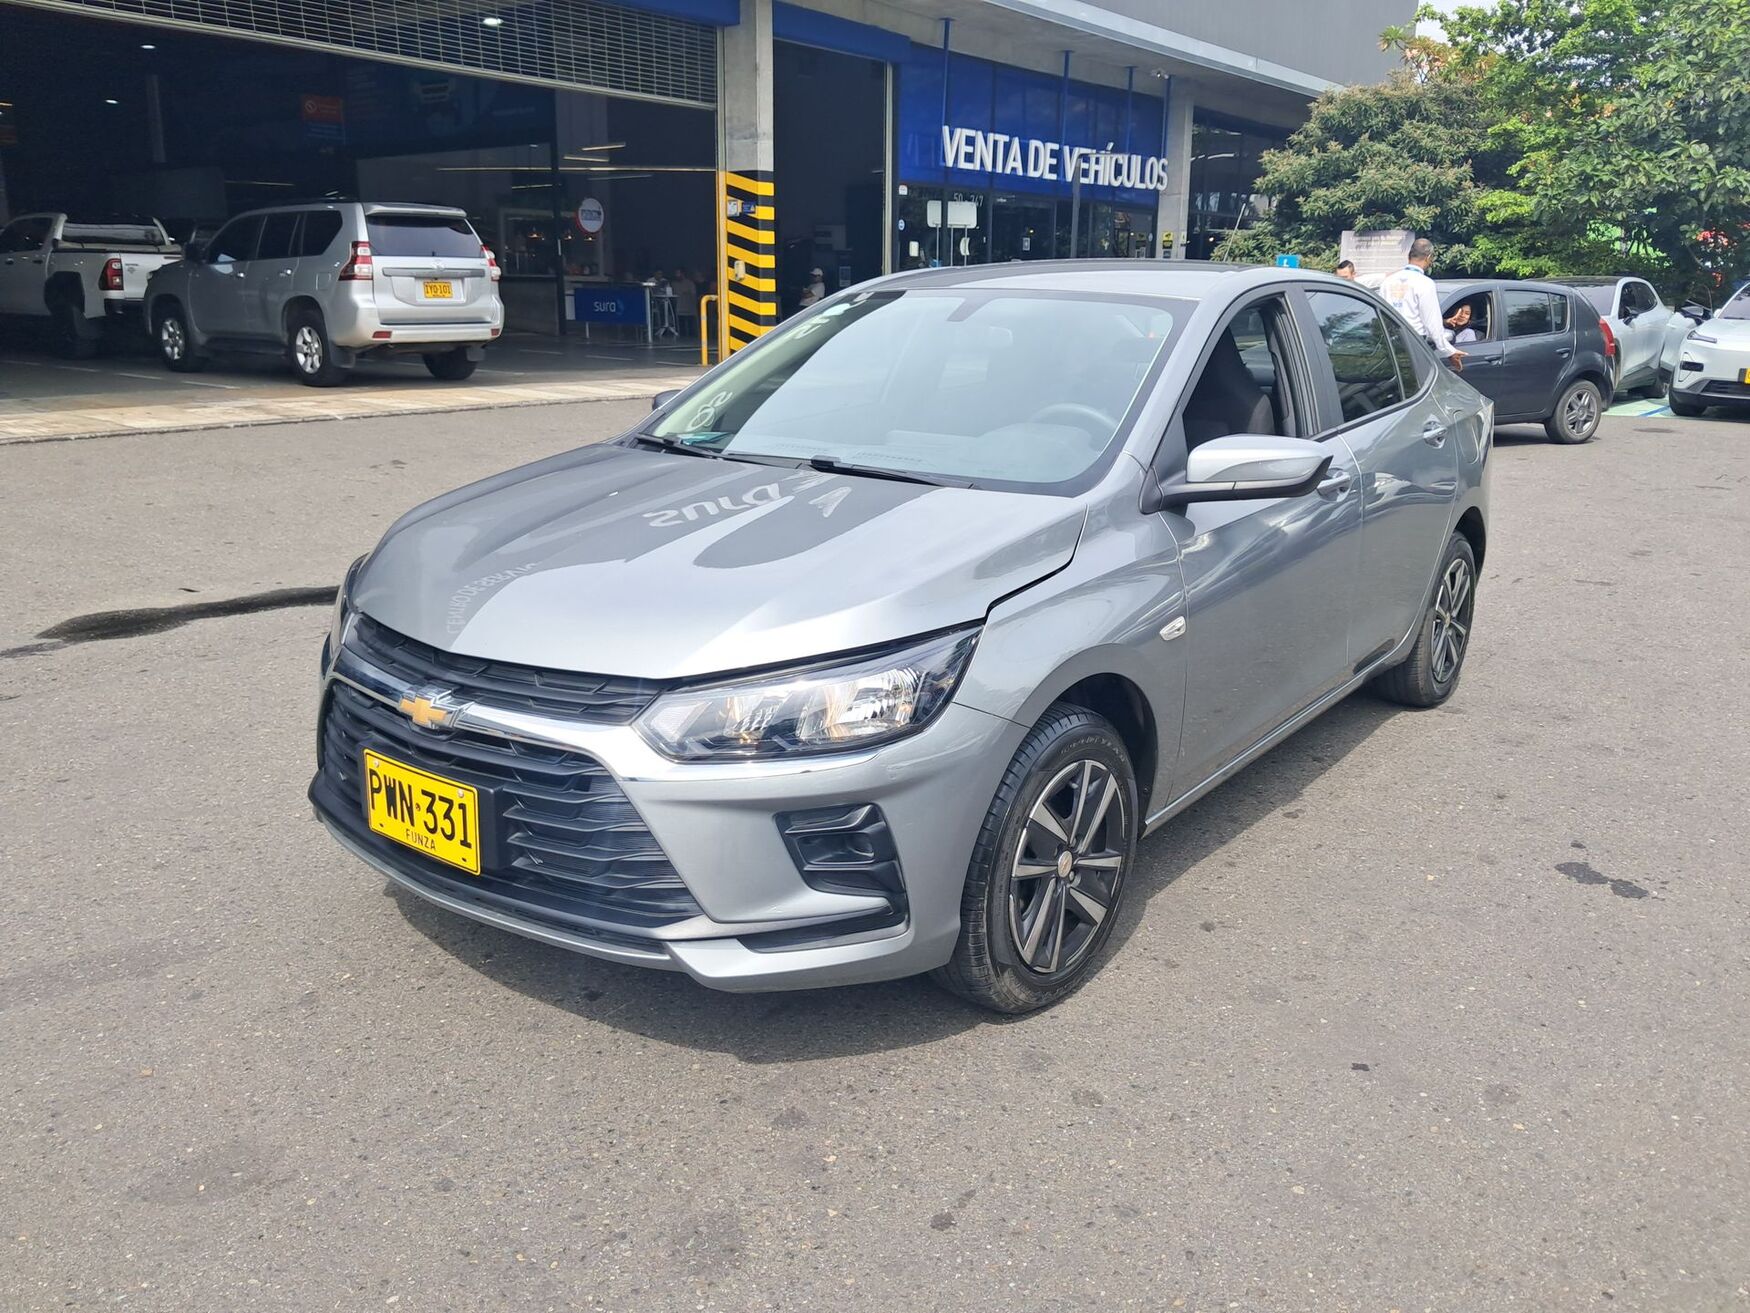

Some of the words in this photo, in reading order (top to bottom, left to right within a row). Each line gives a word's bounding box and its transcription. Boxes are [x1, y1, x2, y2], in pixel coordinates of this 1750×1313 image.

[942, 125, 1023, 176] VENTA
[1027, 139, 1060, 180] DE
[1063, 142, 1168, 191] VEHÍCULOS
[593, 301, 616, 312] sura
[406, 829, 436, 851] FUNZA
